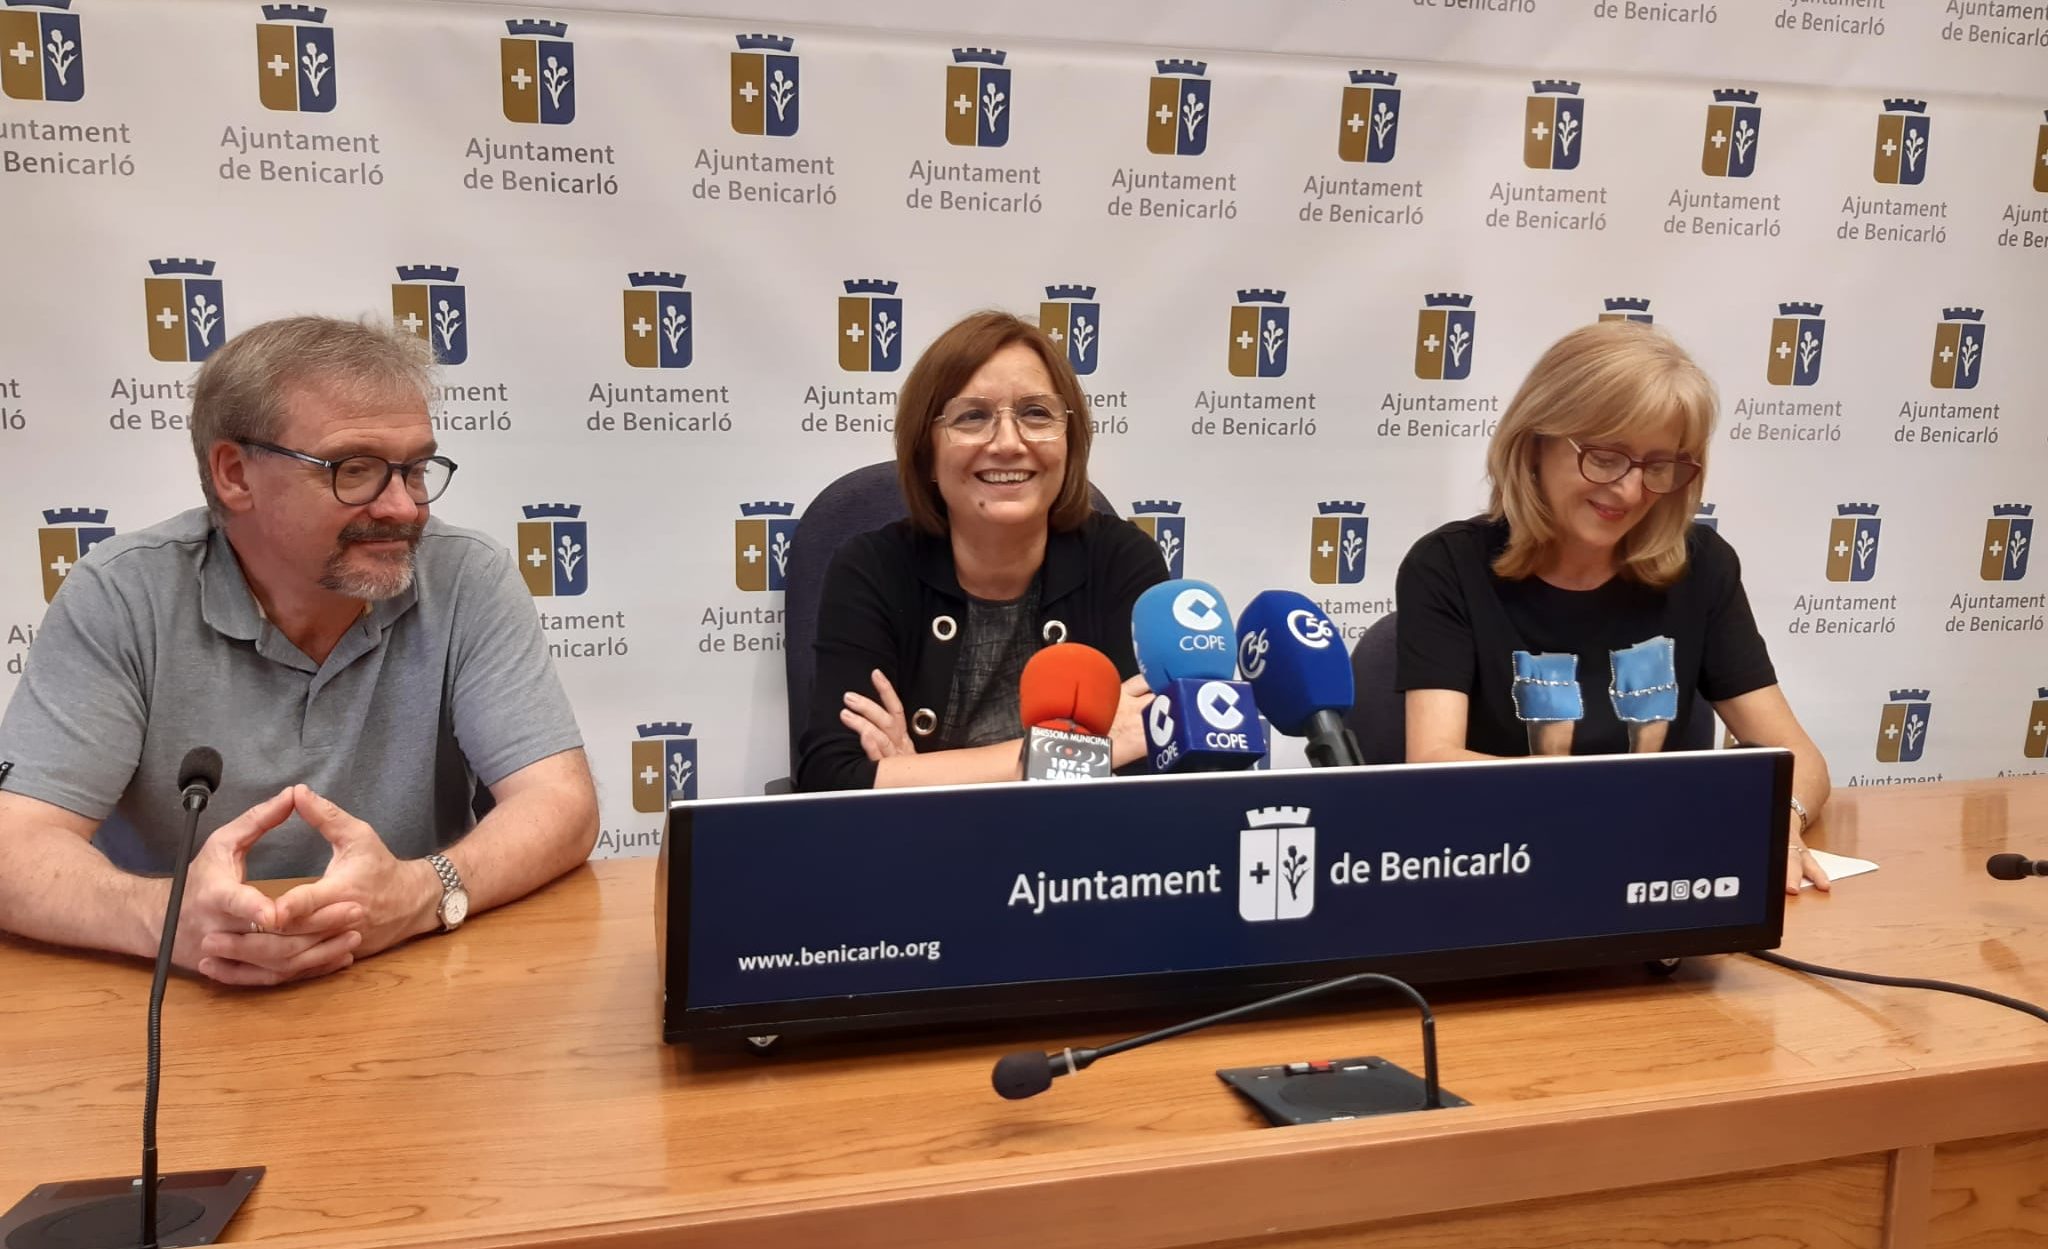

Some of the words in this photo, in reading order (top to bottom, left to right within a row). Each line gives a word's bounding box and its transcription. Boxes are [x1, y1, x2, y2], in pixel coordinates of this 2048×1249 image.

[1593, 0, 1618, 19] de
[1624, 1, 1717, 24] Benicarló
[1774, 8, 1797, 30] de
[1801, 11, 1885, 36] Benicarló
[1941, 21, 1964, 42] de
[1968, 24, 2048, 47] Benicarló
[0, 119, 132, 144] untament
[220, 125, 380, 155] Ajuntament
[465, 137, 615, 165] Ajuntament
[694, 148, 835, 176] Ajuntament
[3, 150, 136, 177] Benicarló
[219, 156, 252, 181] de
[259, 159, 384, 186] Benicarló
[909, 159, 1041, 186] Ajuntament
[463, 167, 494, 190] de
[502, 170, 619, 196] Benicarló
[692, 177, 721, 200] de
[728, 180, 837, 205] Benicarló
[1111, 168, 1237, 194] Ajuntament
[1303, 175, 1423, 200] Ajuntament
[906, 187, 933, 210] de
[940, 190, 1042, 214] Benicarló
[1489, 182, 1608, 206] Ajuntament
[1667, 188, 1781, 213] Ajuntament
[1107, 195, 1133, 217] de
[1139, 197, 1237, 220] Benicarló
[1298, 201, 1324, 222] de
[1329, 203, 1424, 225] Benicarló
[1485, 207, 1510, 228] de
[1515, 209, 1607, 231] Benicarló
[1841, 195, 1948, 220] Ajuntament
[2002, 204, 2048, 227] Ajunt
[1663, 214, 1687, 234] de
[1691, 216, 1781, 237] Benicarló
[1836, 220, 1859, 240] de
[1864, 222, 1947, 244] Benicarló
[1997, 229, 2018, 248] de
[110, 377, 196, 406] Ajunta
[588, 382, 730, 409] Ajuntament
[804, 385, 897, 410] Ajuntam
[1194, 390, 1317, 414] Ajuntament
[1380, 392, 1498, 417] Ajuntament
[1734, 397, 1843, 421] Ajuntament
[1898, 401, 2001, 423] Ajuntament
[109, 407, 142, 430] de
[431, 408, 512, 432] nicarló
[586, 410, 616, 431] de
[623, 411, 732, 432] Benicarló
[801, 412, 828, 433] de
[836, 414, 894, 433] Benic
[1191, 415, 1216, 436] de
[1222, 416, 1317, 436] Benicarló
[1377, 418, 1401, 437] de
[1406, 418, 1498, 438] Benicarló
[1729, 422, 1753, 441] de
[1757, 423, 1841, 442] Benicarló
[1894, 424, 1916, 443] de
[1920, 425, 1999, 444] Benicarló
[1793, 594, 1897, 616] Ajuntament
[1949, 593, 2046, 614] Ajuntament
[539, 611, 626, 631] tament
[1788, 616, 1811, 634] de
[1816, 616, 1896, 634] Benicarló
[1945, 615, 1966, 632] de
[1969, 614, 2044, 632] Benicarló
[548, 636, 629, 659] nicarló
[698, 632, 726, 653] de
[1179, 634, 1226, 651] COPE
[1070, 733, 1110, 746] MUNICIPAL
[1206, 732, 1249, 749] COPE
[1051, 757, 1091, 773] 107.3
[1156, 741, 1180, 770] COPE
[597, 828, 661, 853] Ajunt
[1007, 863, 1222, 915] Ajuntament
[1330, 851, 1371, 885] de
[1380, 842, 1531, 882] Benicarló
[738, 940, 941, 971] www.benicarlo.org
